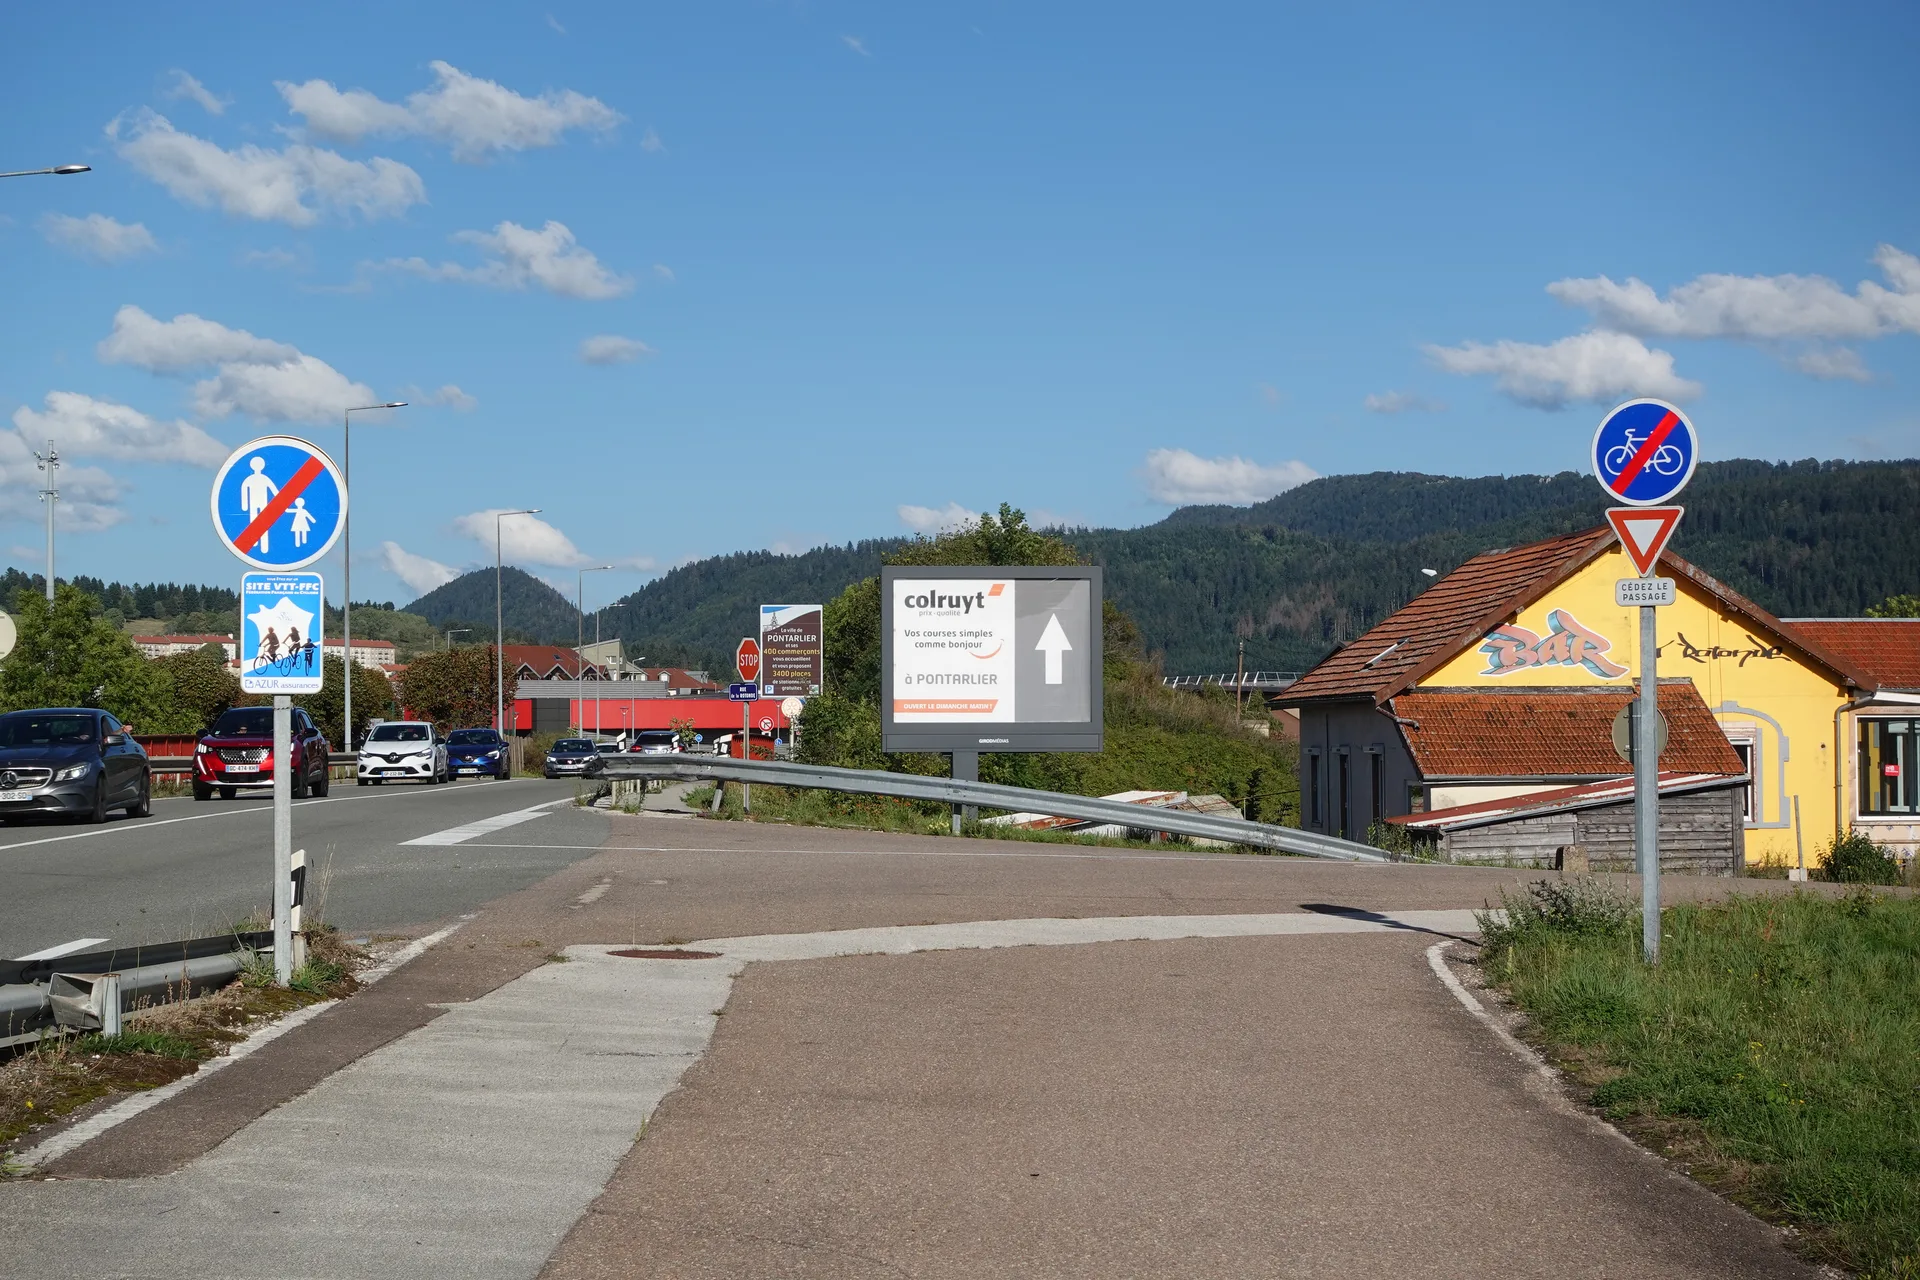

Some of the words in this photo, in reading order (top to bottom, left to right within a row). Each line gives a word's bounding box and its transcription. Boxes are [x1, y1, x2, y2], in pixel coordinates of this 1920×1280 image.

[246, 582, 271, 590] SITE
[274, 582, 320, 590] VTT-FFC
[1621, 582, 1653, 591] CÉDEZ
[1656, 582, 1668, 590] LE
[1622, 592, 1667, 601] PASSAGE
[904, 589, 985, 615] colruyt
[918, 610, 932, 618] prix
[904, 629, 920, 638] Vos
[959, 629, 993, 639] simples
[948, 640, 983, 650] bonjour
[1478, 608, 1630, 679] BAR
[777, 648, 820, 656] commerçants
[740, 654, 759, 666] STOP
[254, 680, 279, 688] AZUR
[904, 674, 912, 685] à
[916, 674, 998, 685] PONTARLIER
